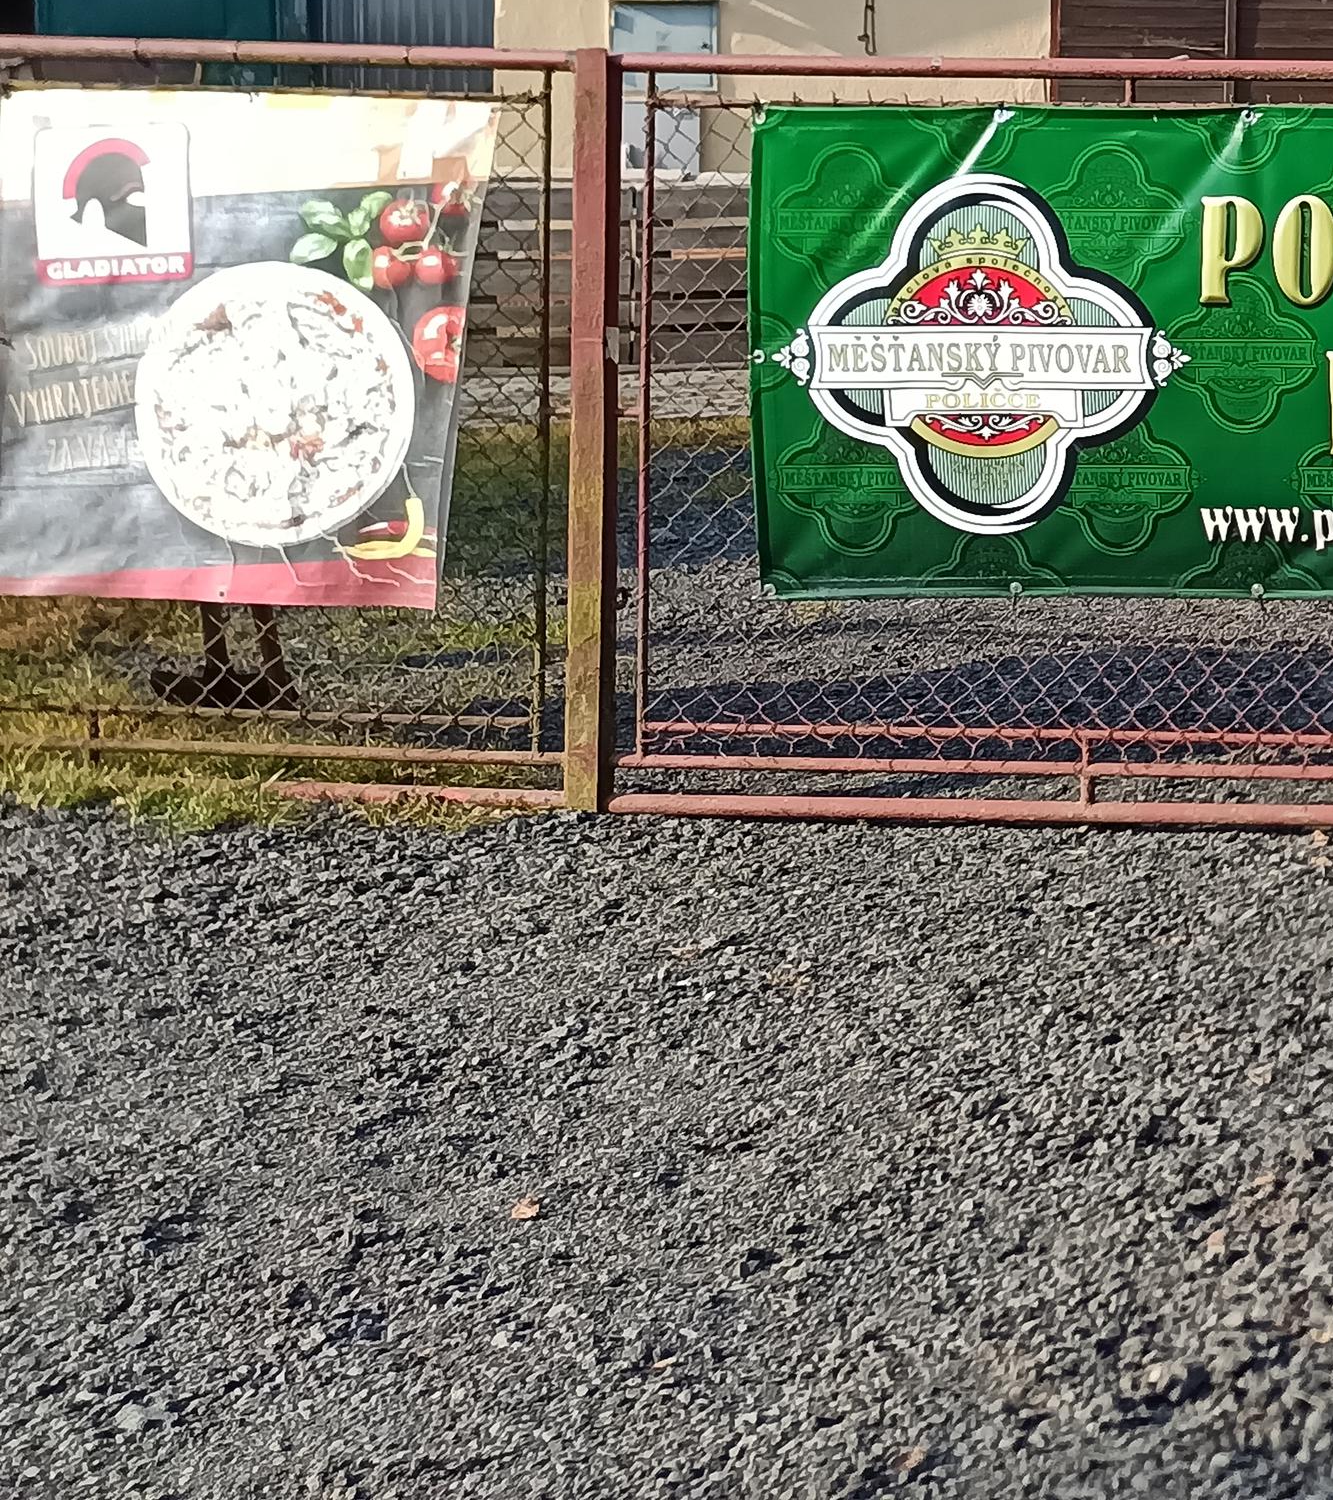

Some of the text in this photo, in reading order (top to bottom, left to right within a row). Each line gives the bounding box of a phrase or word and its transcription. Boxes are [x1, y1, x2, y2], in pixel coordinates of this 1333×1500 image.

[46, 254, 187, 281] GLADIATOR
[966, 255, 1067, 311] společnost
[23, 329, 98, 371] SOUBOJ
[828, 335, 1132, 373] MĚŠŤANSKÝ PIVOVAR
[8, 370, 136, 427] VYHRAJEME
[925, 388, 1042, 409] POLIČCE
